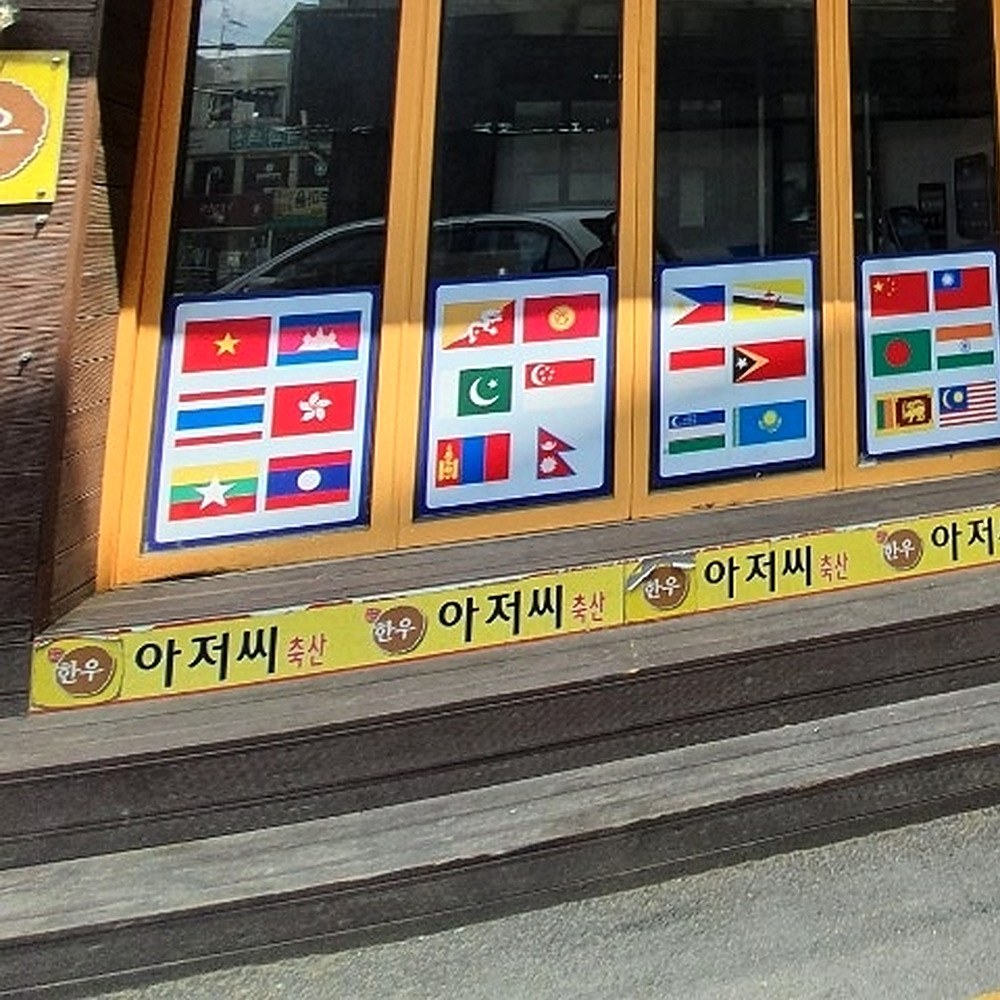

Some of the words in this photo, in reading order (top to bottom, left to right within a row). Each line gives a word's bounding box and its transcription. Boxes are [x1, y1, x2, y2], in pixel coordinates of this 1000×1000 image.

[645, 575, 680, 599] 한우
[704, 545, 812, 599] 아저씨
[820, 552, 849, 582] 축산
[884, 539, 916, 560] 한우
[56, 658, 104, 684] 한우
[135, 626, 279, 688] 아저씨
[287, 633, 328, 668] 축산
[374, 619, 417, 643] 한우
[438, 585, 563, 643] 아저씨
[571, 591, 606, 623] 축산
